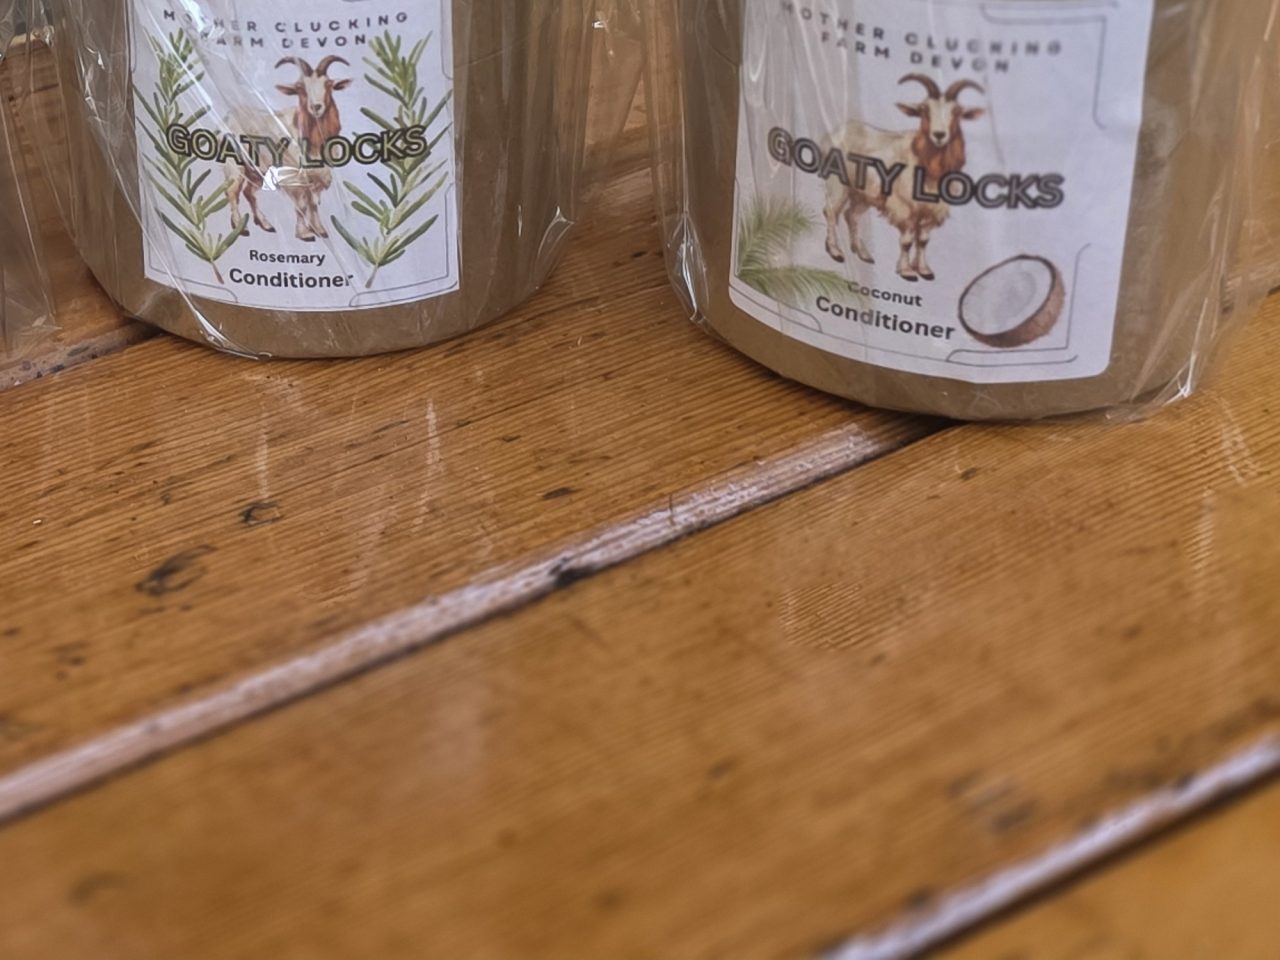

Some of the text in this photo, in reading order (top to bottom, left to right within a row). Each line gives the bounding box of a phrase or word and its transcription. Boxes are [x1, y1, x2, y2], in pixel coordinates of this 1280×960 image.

[163, 9, 408, 33] MHER CLUCKING
[781, 0, 1062, 57] MOTHER CLUCKING
[282, 34, 367, 49] DEVON
[821, 31, 1009, 73] FARM DEVON
[165, 123, 430, 169] GOATY LOCKS
[767, 126, 1065, 210] GOATY LOCKS
[248, 249, 326, 266] Rosemary
[228, 268, 355, 289] Conditioner
[847, 279, 924, 309] Coconut
[815, 295, 957, 341] Conditioner
